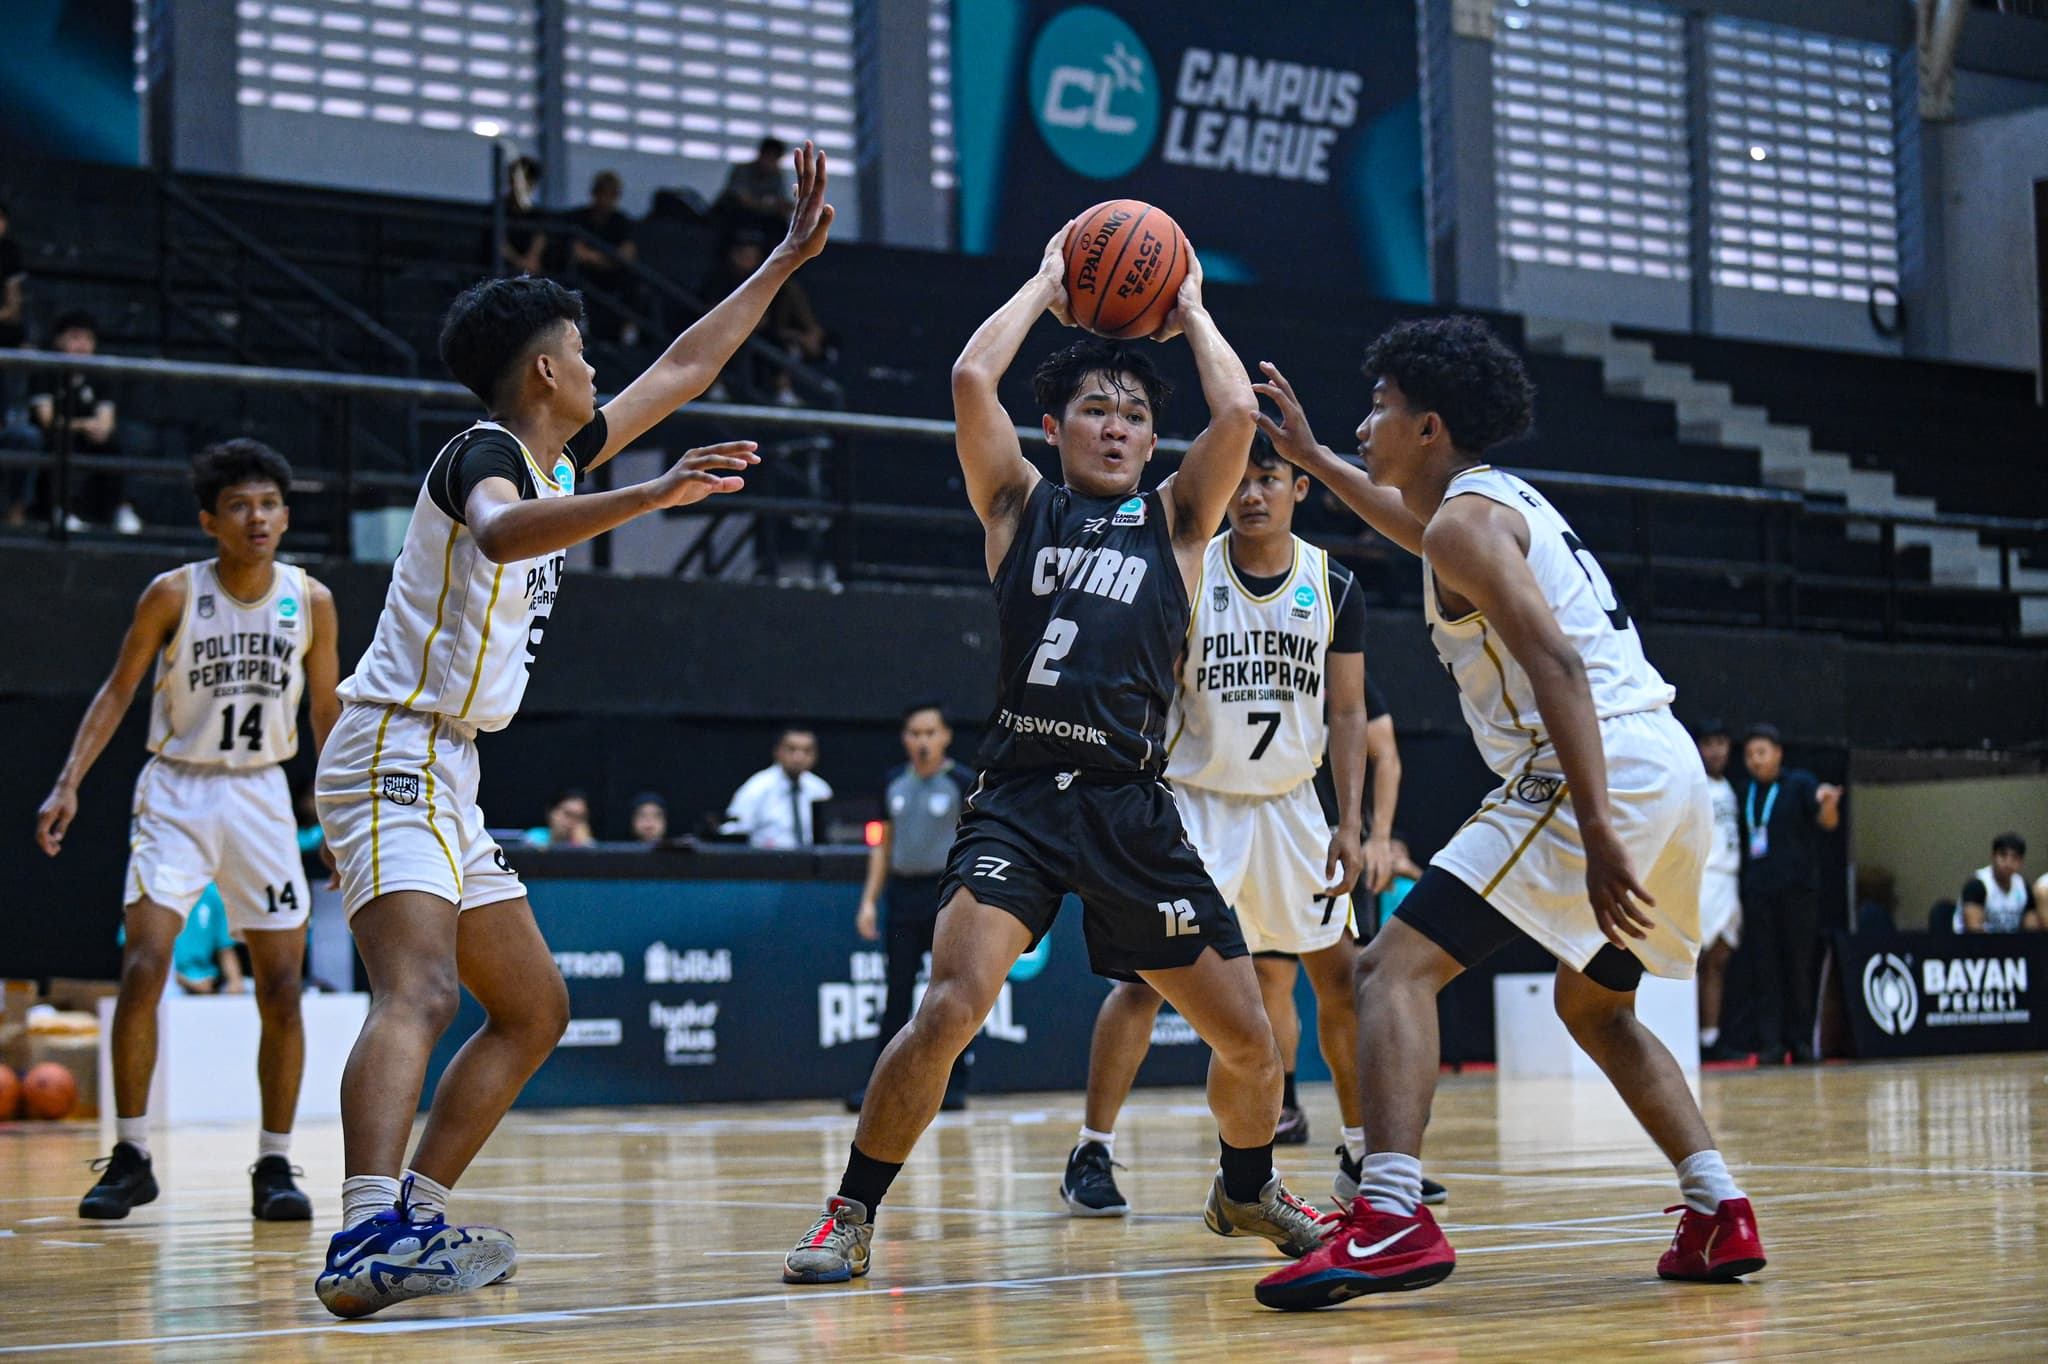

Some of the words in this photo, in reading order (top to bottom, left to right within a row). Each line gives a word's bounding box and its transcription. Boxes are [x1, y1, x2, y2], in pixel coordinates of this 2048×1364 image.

[1176, 48, 1364, 129] CAMPUS
[1162, 107, 1338, 183] LEAGUE
[1077, 209, 1132, 295] SPALDING
[1117, 230, 1155, 299] REACT
[1026, 617, 1079, 687] 2
[1221, 688, 1257, 703] NEGERI
[219, 703, 263, 752] 14
[1247, 711, 1281, 761] 7
[385, 775, 418, 792] SHIPS
[265, 881, 299, 912] 14
[1157, 898, 1200, 937] 12
[1922, 957, 2028, 994] BAYAN
